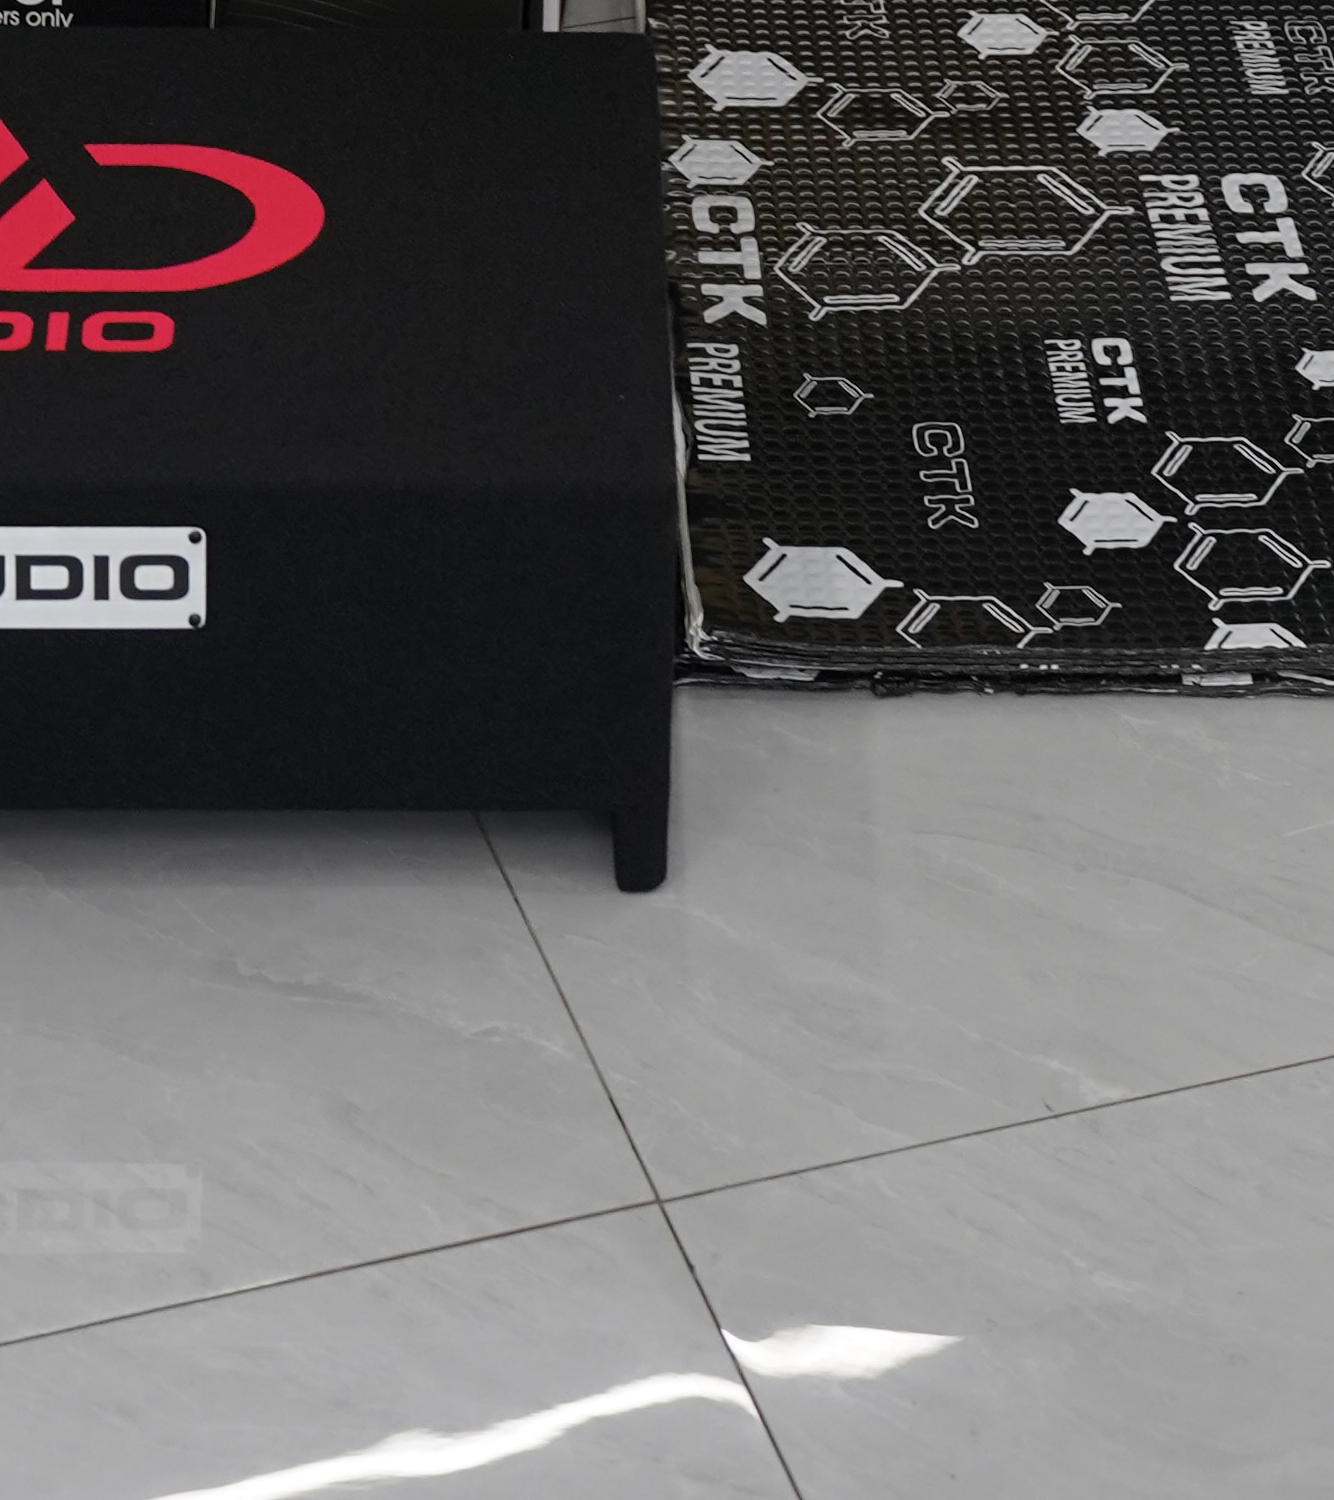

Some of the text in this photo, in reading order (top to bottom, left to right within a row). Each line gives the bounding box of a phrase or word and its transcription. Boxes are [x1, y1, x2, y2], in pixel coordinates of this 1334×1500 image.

[25, 8, 75, 29] only
[1229, 19, 1289, 96] PREMIUM
[691, 194, 768, 328] CTK
[1137, 173, 1232, 303] PREMIUM
[1220, 172, 1318, 304] CTK
[685, 342, 753, 463] PREMIUM
[1044, 338, 1096, 425] PREMIUM
[1091, 337, 1148, 426] CTK
[912, 421, 980, 531] CTK
